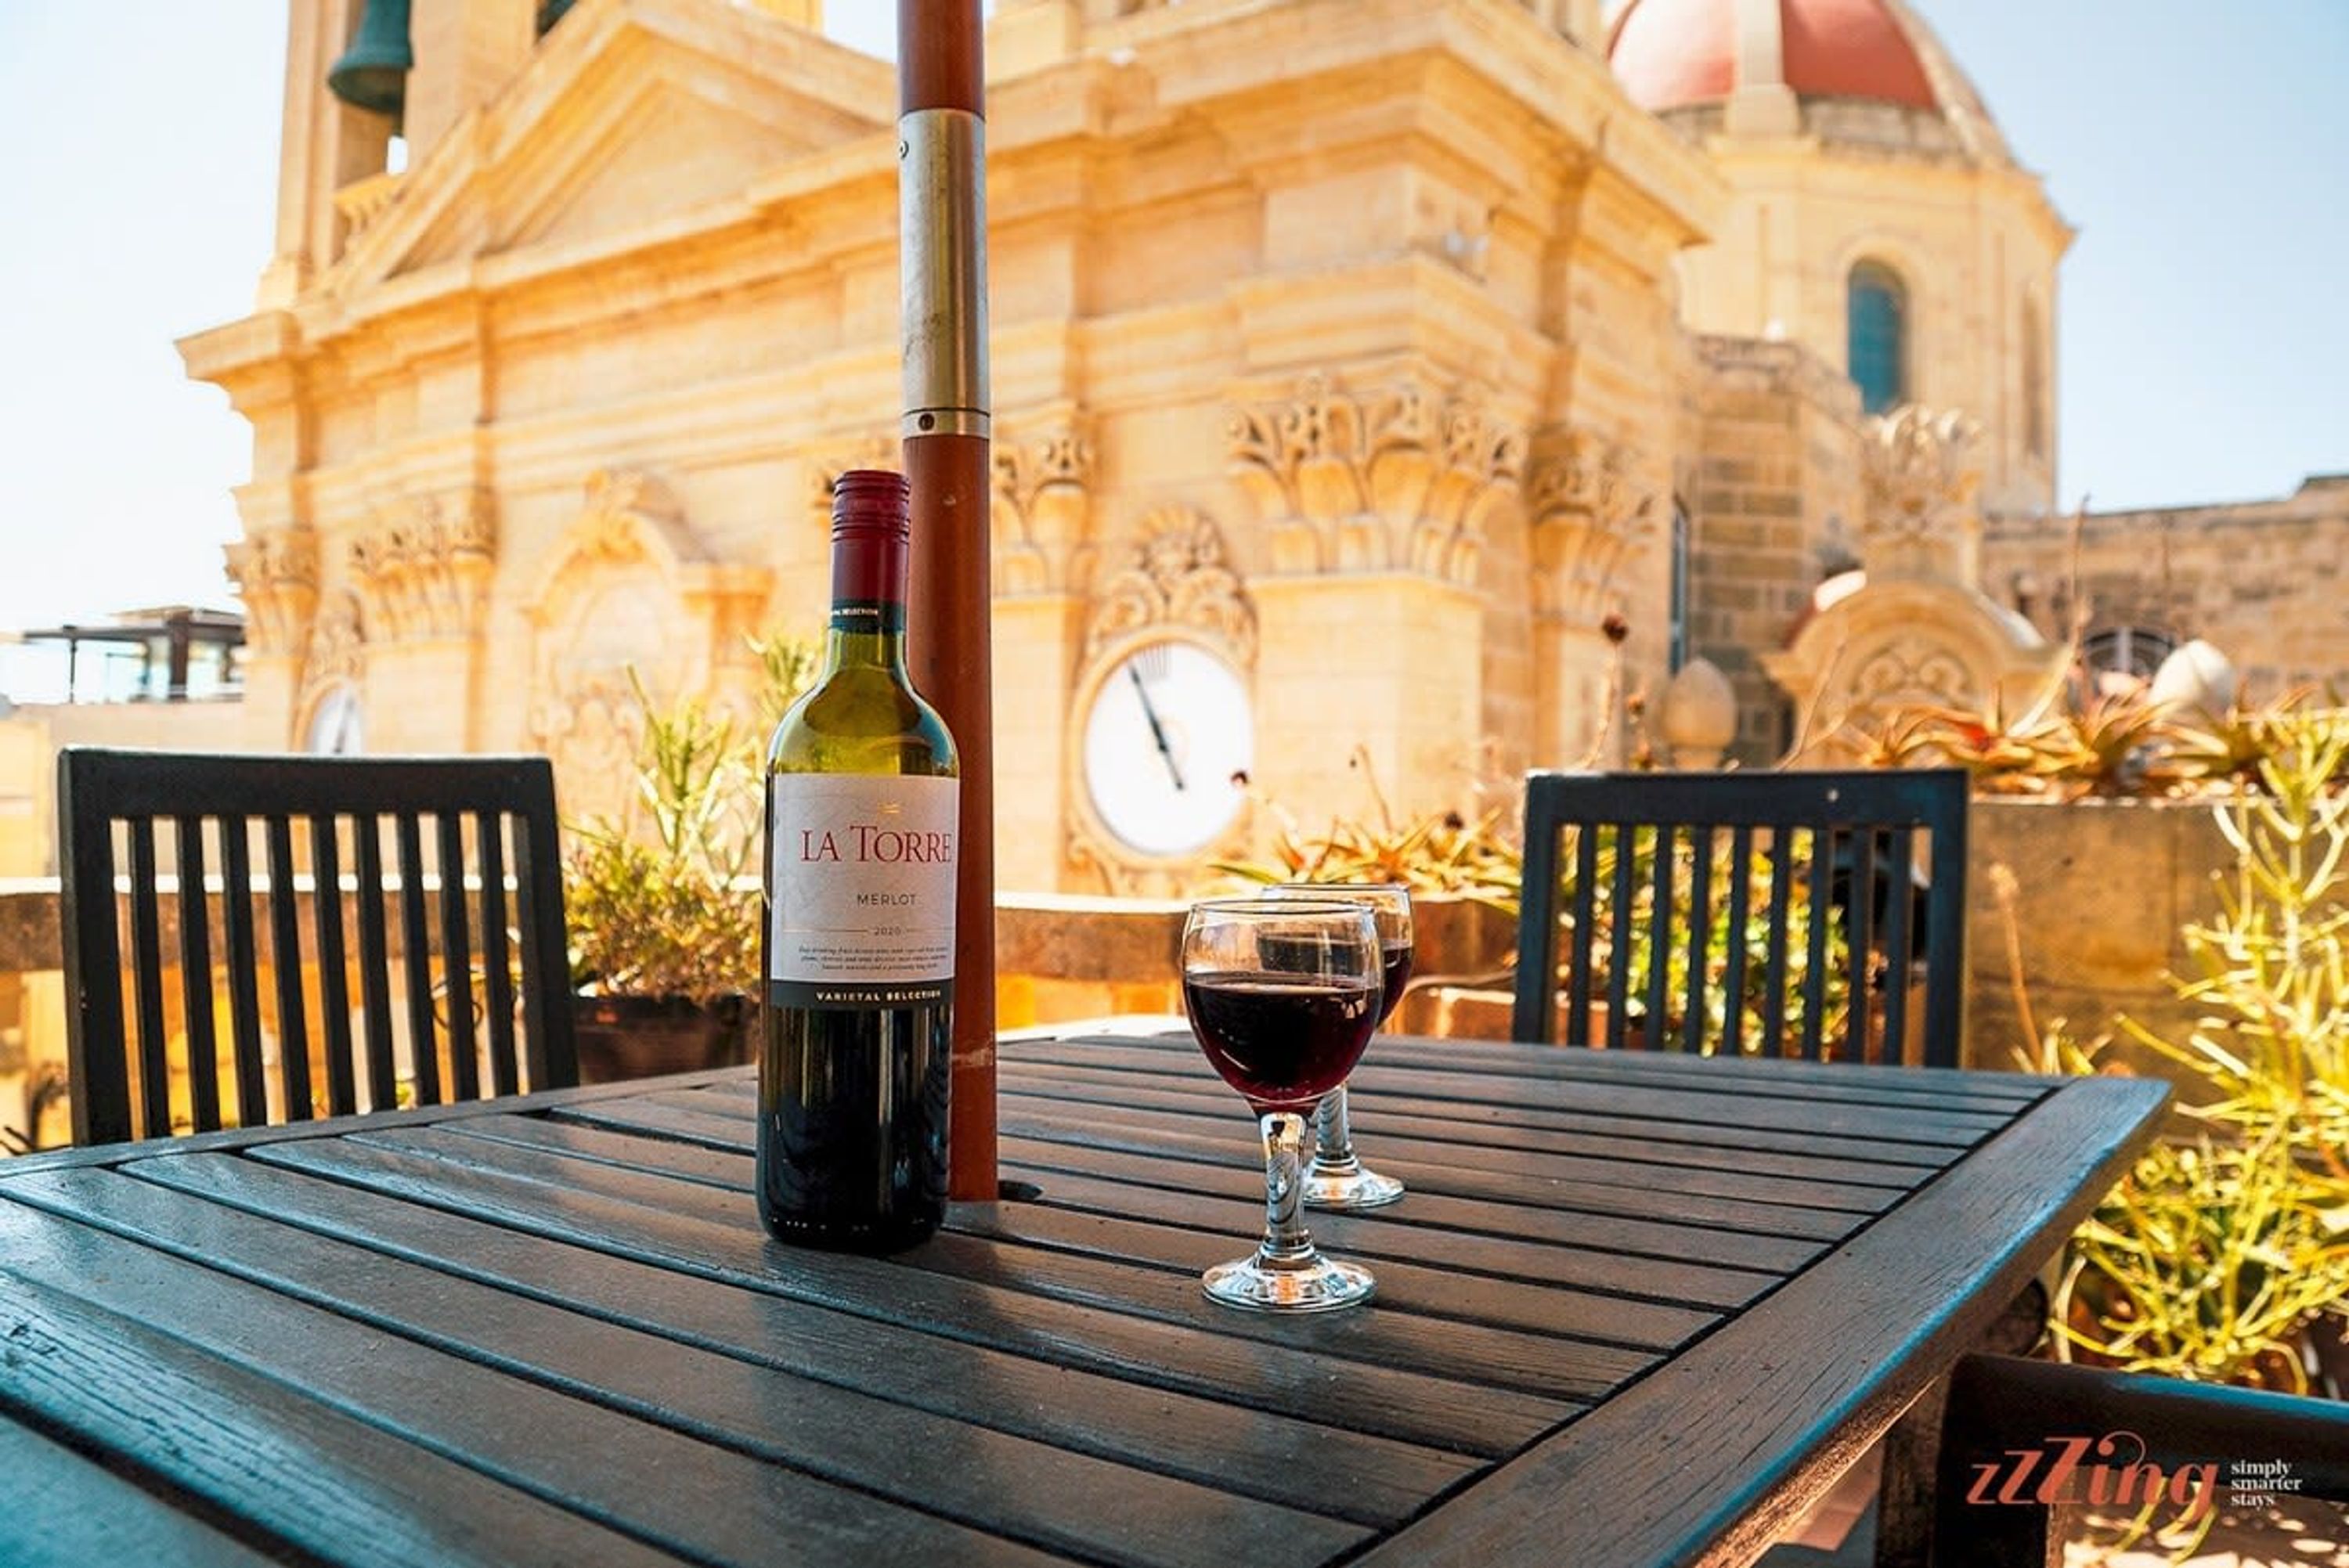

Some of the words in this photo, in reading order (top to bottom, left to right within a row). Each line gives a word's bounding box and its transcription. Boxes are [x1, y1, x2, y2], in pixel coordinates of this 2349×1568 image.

[801, 830, 842, 862] LA
[857, 894, 916, 907] MERLOT
[874, 927, 901, 936] 2020
[816, 991, 880, 1001] VARIETAL
[886, 989, 940, 1001] SELECTION
